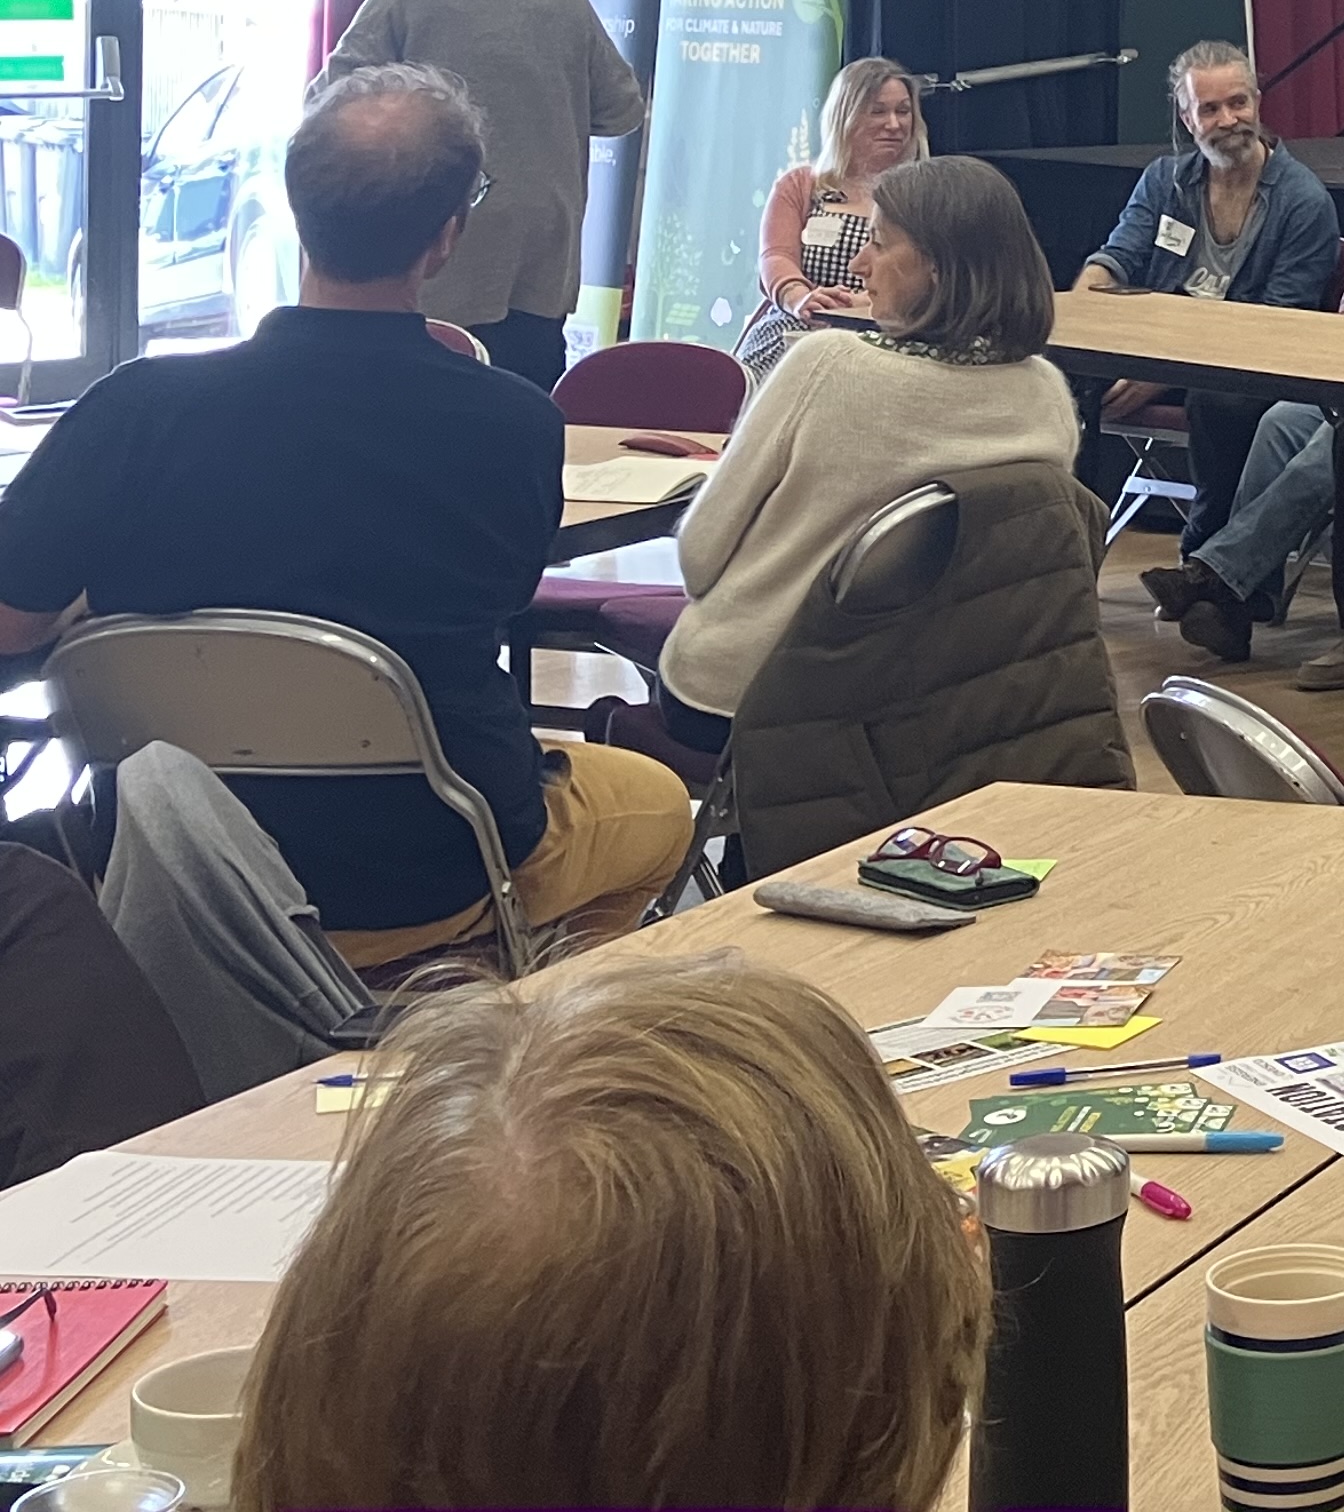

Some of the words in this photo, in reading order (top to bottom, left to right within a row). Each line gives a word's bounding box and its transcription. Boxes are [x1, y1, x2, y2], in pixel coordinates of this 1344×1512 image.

[665, 16, 683, 32] FOR
[685, 17, 729, 34] CLIMATE
[741, 20, 784, 37] NATURE
[679, 40, 762, 64] TOGETHER
